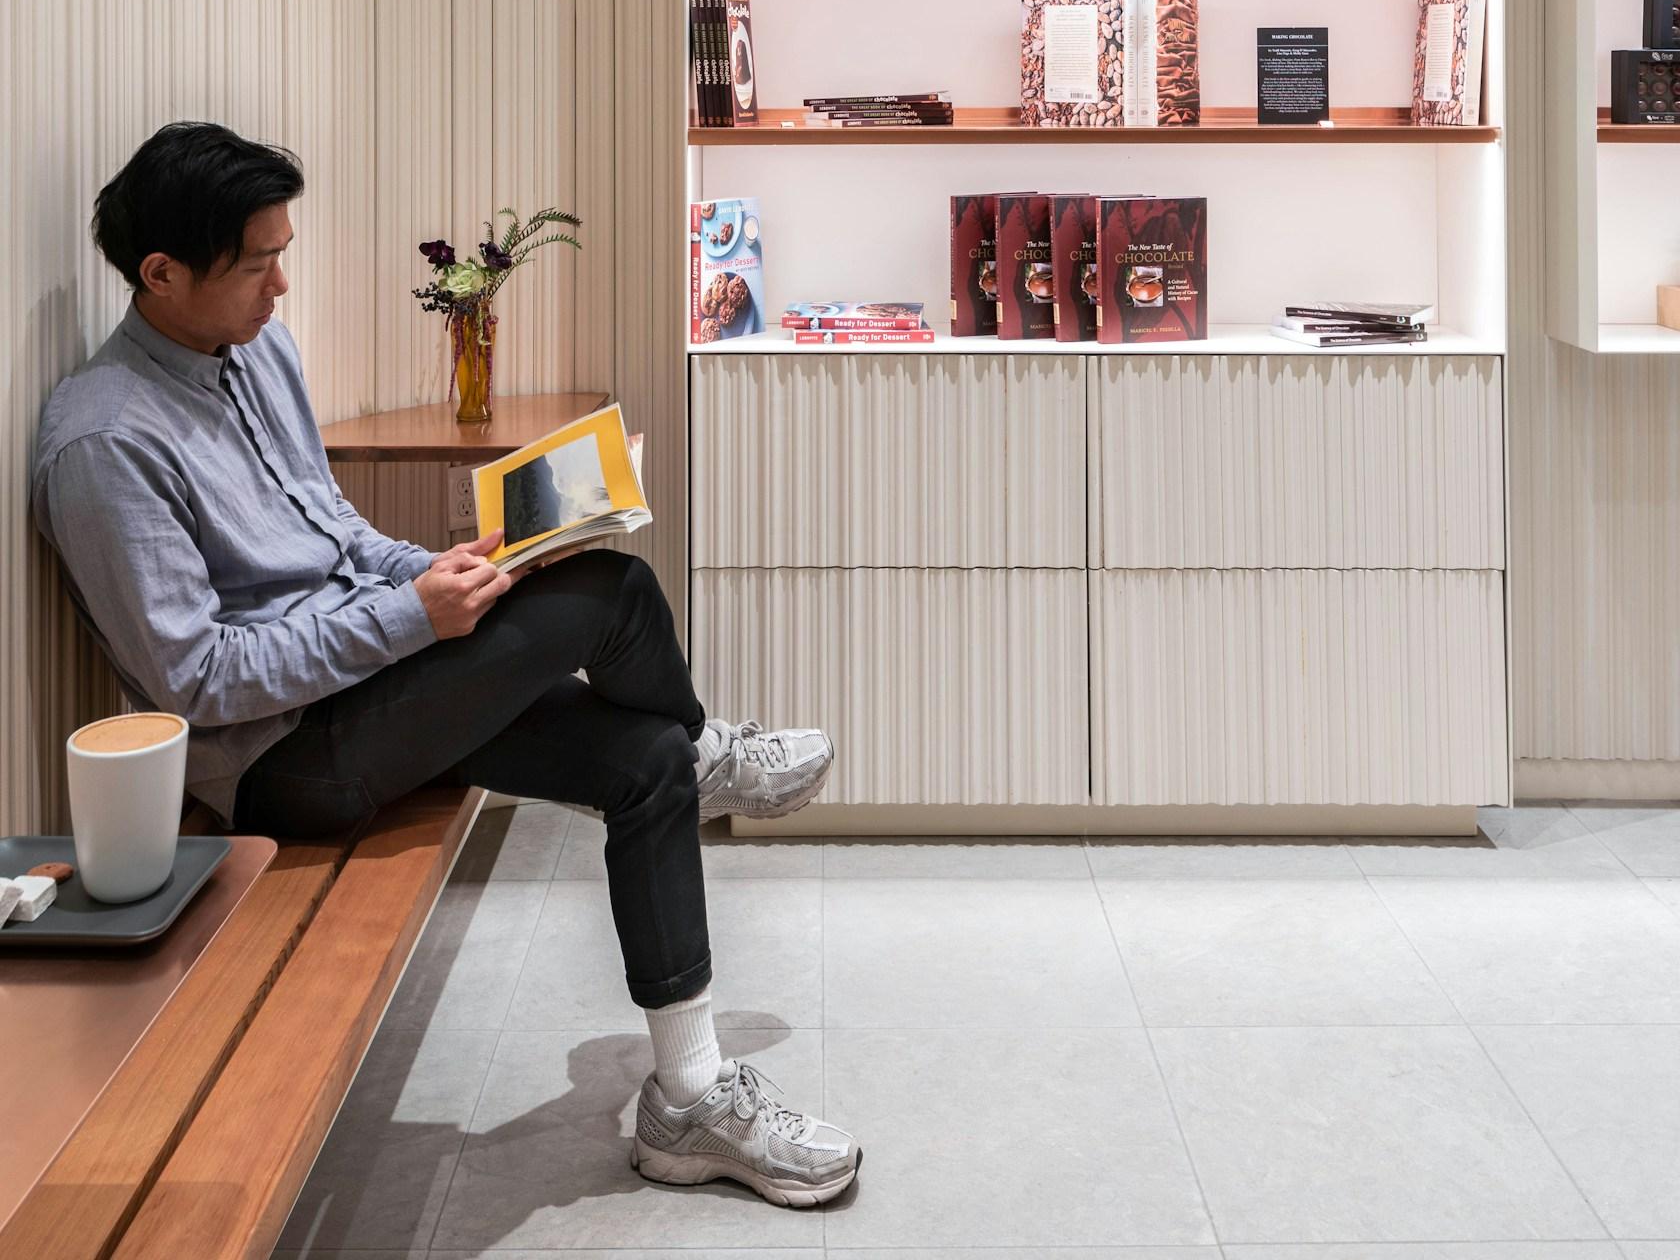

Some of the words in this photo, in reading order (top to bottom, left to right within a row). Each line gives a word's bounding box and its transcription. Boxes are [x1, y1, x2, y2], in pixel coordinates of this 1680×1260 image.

[728, 2, 750, 18] chocolate
[873, 95, 898, 103] chocolate
[1166, 242, 1174, 251] of
[1115, 251, 1194, 264] CHOCOLATE
[692, 257, 700, 278] Ready
[705, 262, 724, 271] Ready
[724, 260, 734, 268] for
[735, 257, 760, 267] Dessert
[835, 320, 856, 328] Ready
[848, 334, 869, 342] Ready
